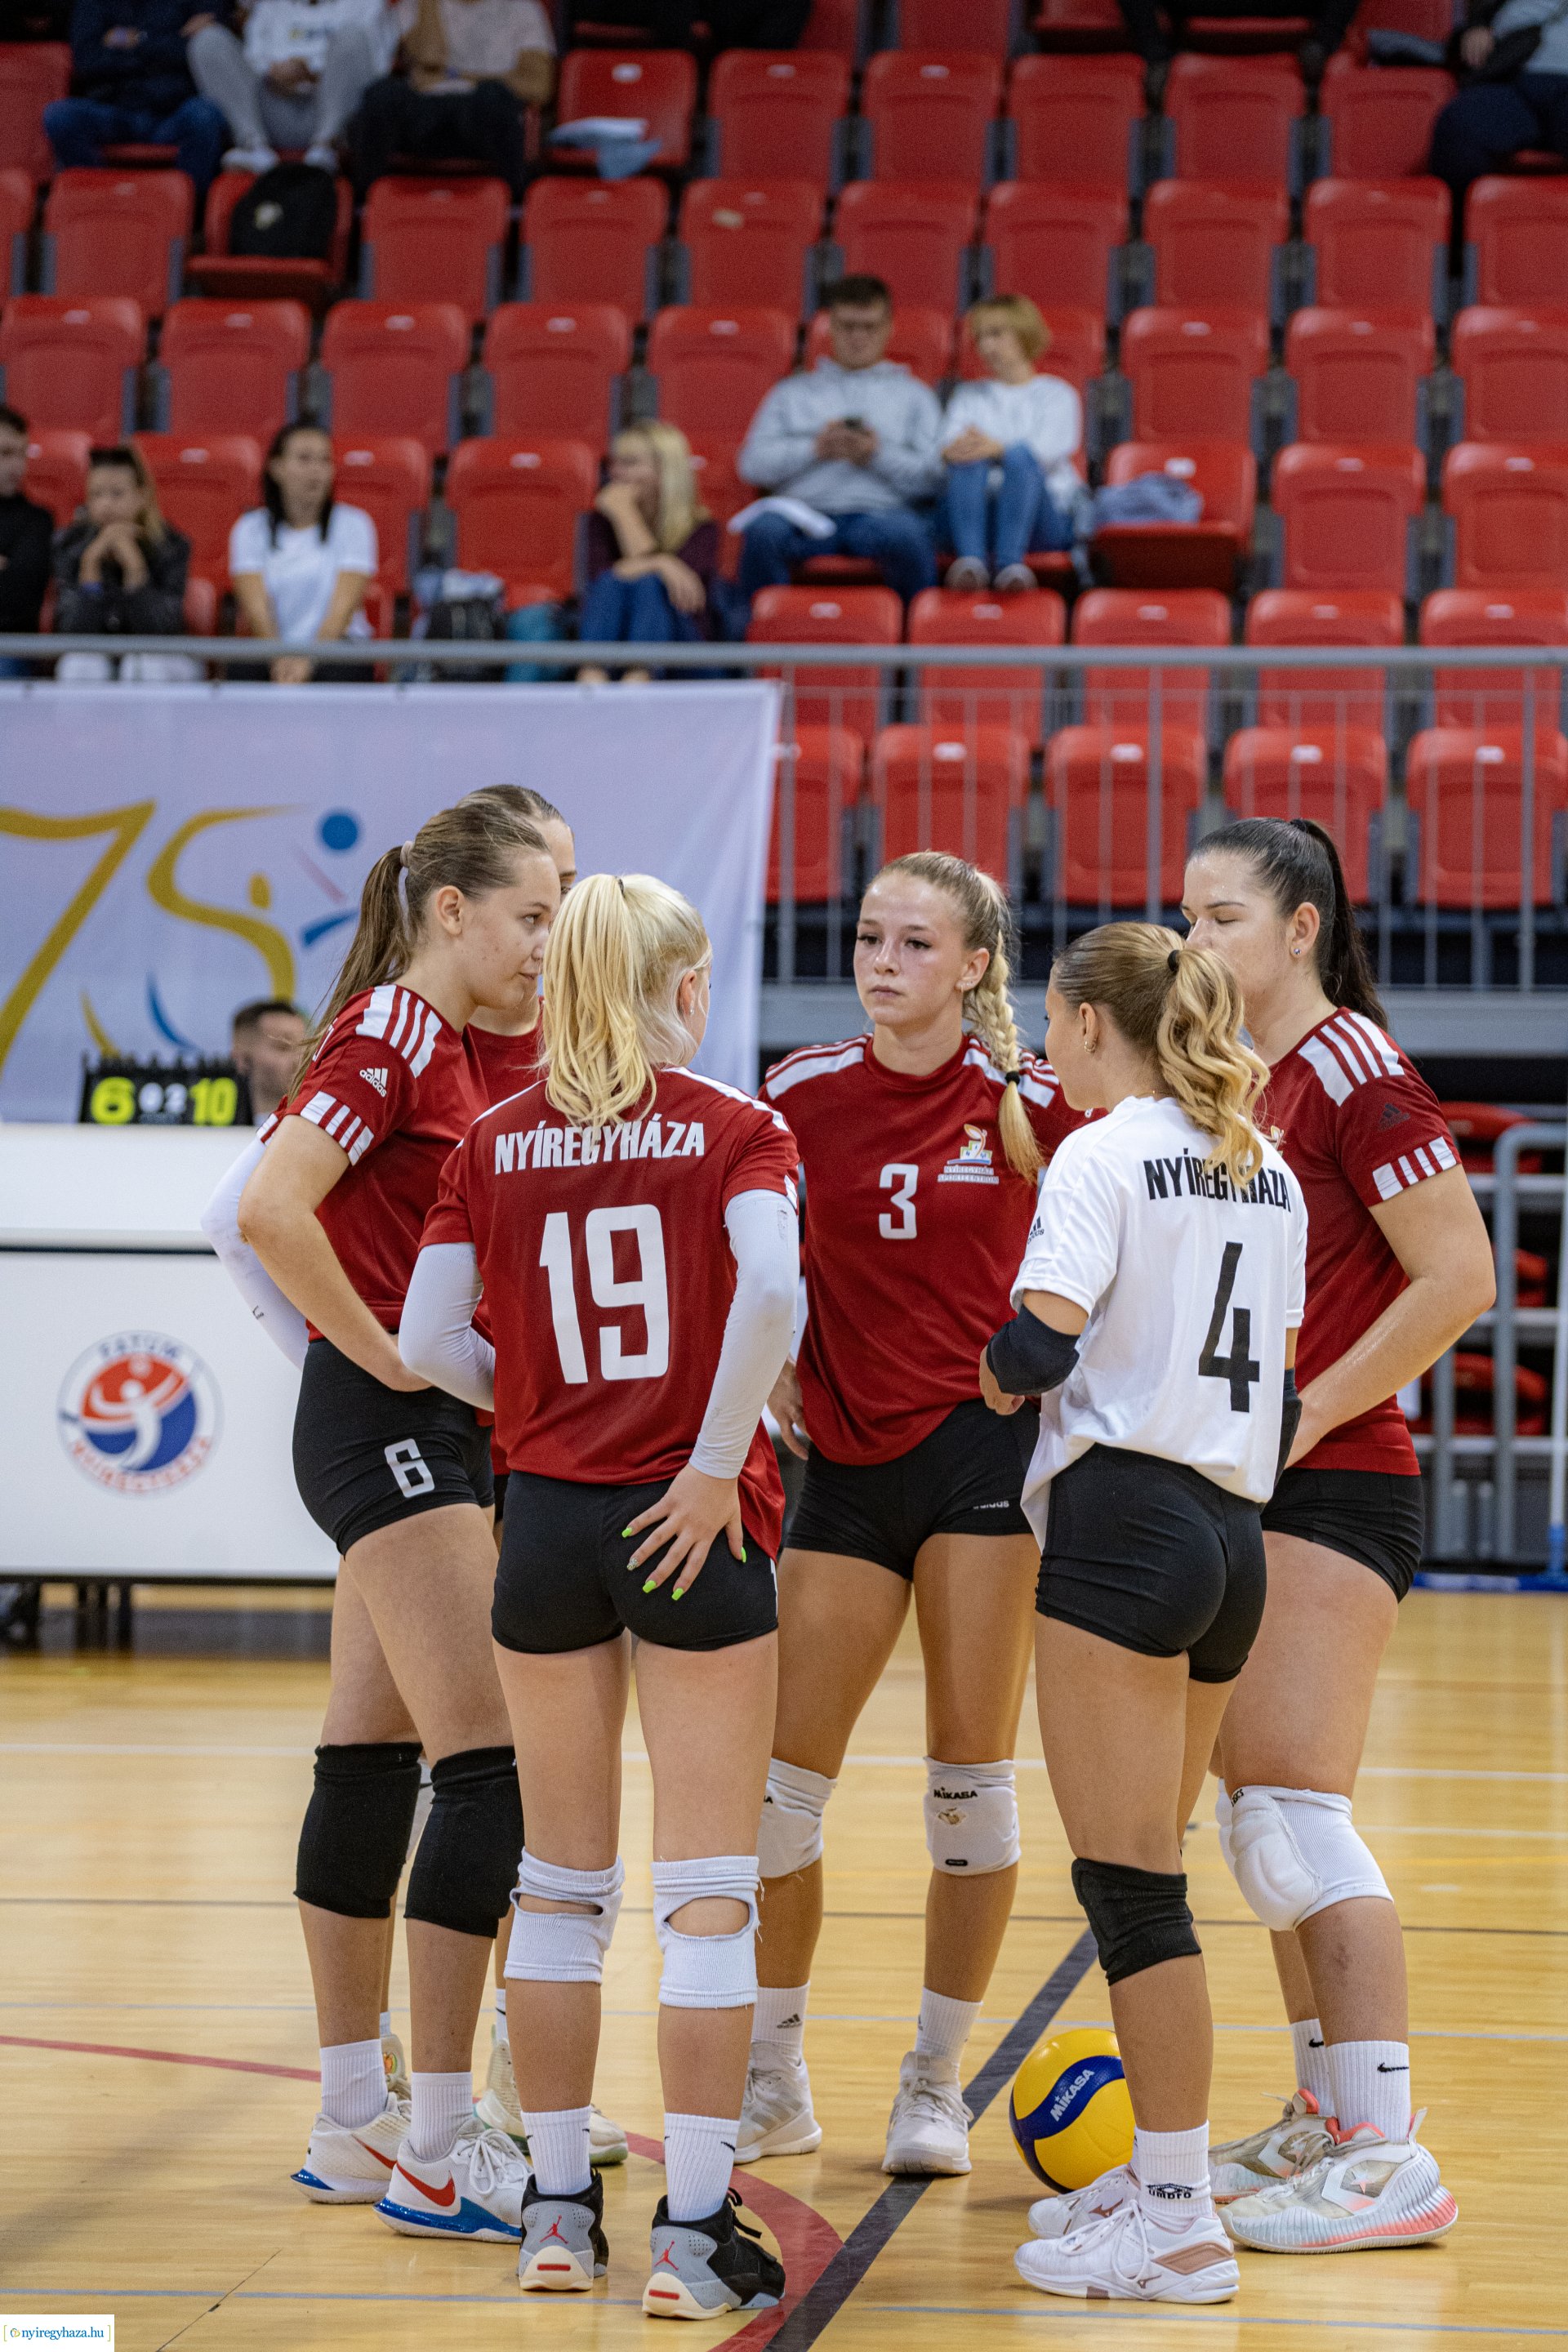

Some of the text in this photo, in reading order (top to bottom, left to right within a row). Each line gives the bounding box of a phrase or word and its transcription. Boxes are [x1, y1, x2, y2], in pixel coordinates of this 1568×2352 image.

[90, 1076, 136, 1125] 6
[189, 1076, 238, 1126] 10
[359, 1069, 387, 1098] adidas
[494, 1113, 706, 1175] NYÍREGYHÁZA
[879, 1163, 919, 1240] 3
[539, 1204, 670, 1385] 19
[1198, 1241, 1260, 1413] 4
[384, 1438, 435, 1498] 6
